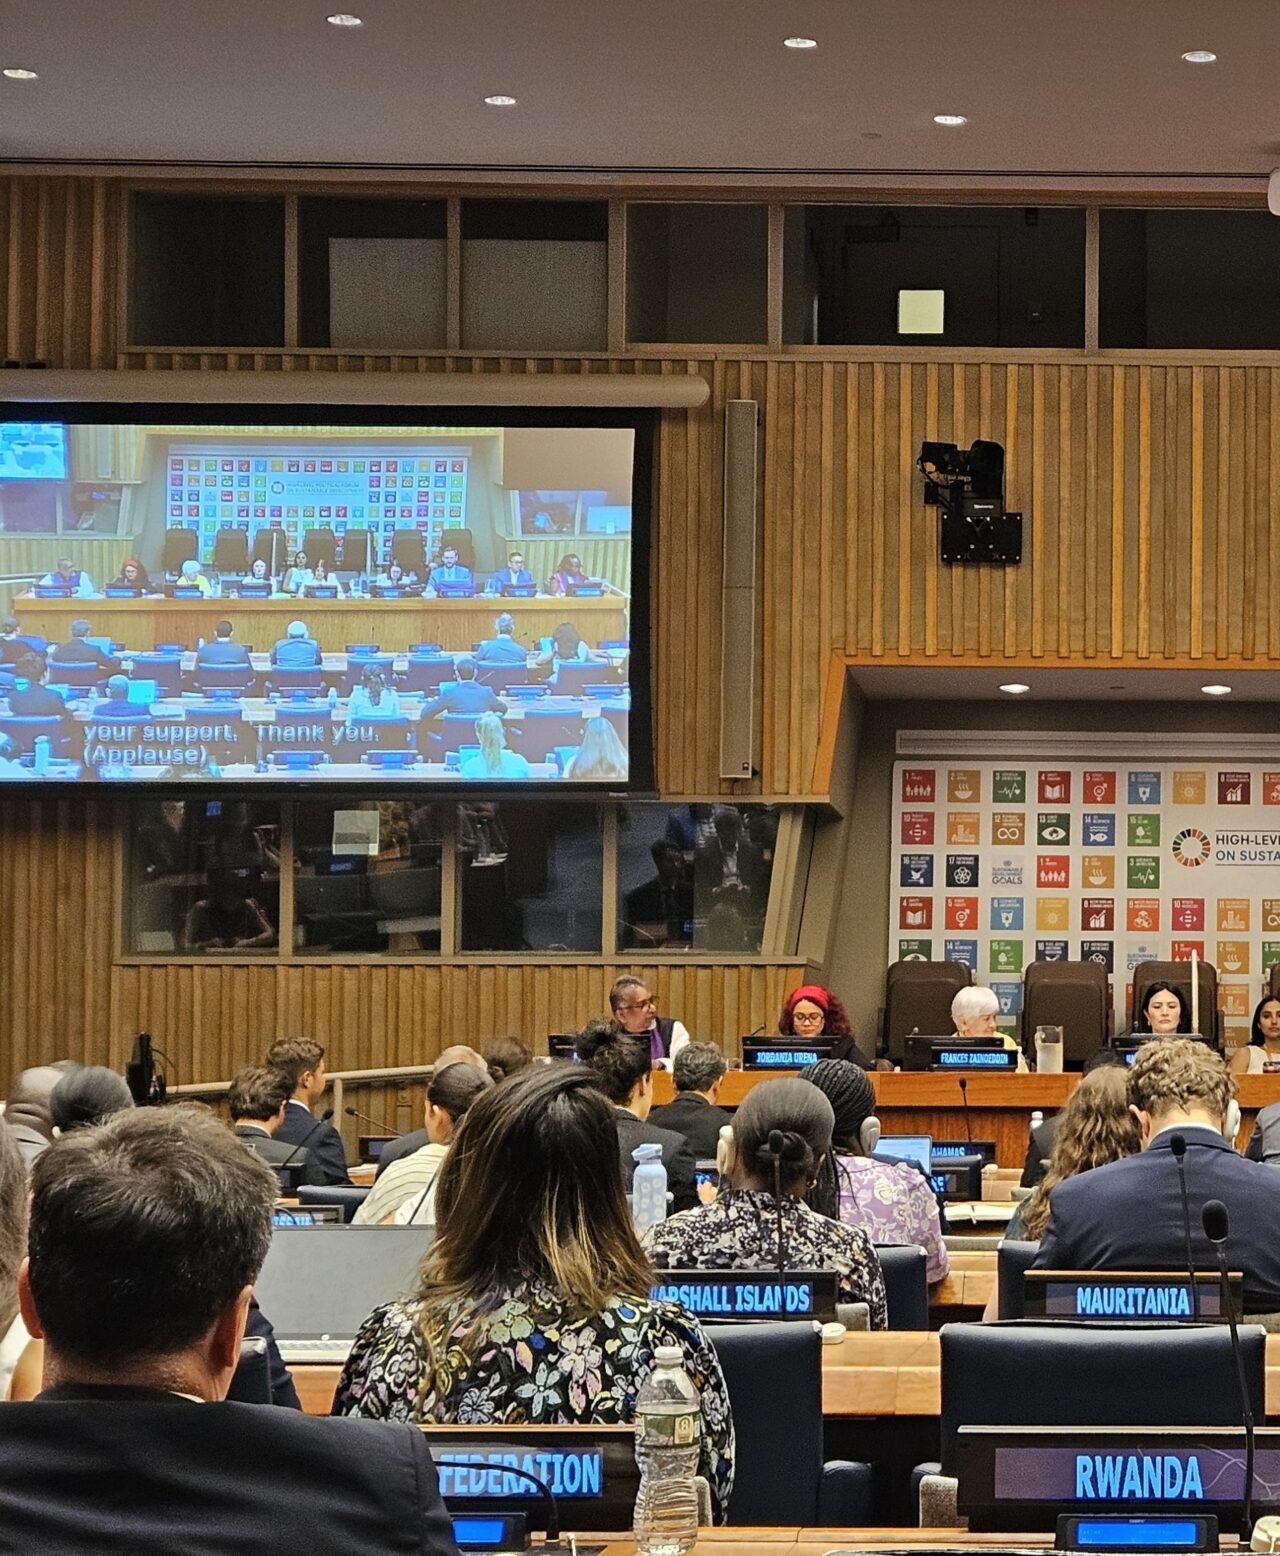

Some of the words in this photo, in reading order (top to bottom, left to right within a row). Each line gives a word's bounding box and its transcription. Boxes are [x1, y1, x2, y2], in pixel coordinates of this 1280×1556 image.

[84, 725, 135, 746] your
[142, 724, 238, 746] support.
[256, 724, 325, 742] Thank
[331, 725, 380, 746] you.
[84, 745, 208, 767] (Applause)
[1216, 850, 1235, 861] ON
[992, 876, 1023, 885] GOALS
[940, 1052, 968, 1064] FRANCES
[931, 1146, 966, 1157] AHAMAS
[735, 1284, 810, 1312] ISLANDS
[1076, 1287, 1191, 1315] MAURITANIA
[438, 1453, 600, 1494] FEDERATION
[1075, 1455, 1204, 1499] RWANDA
